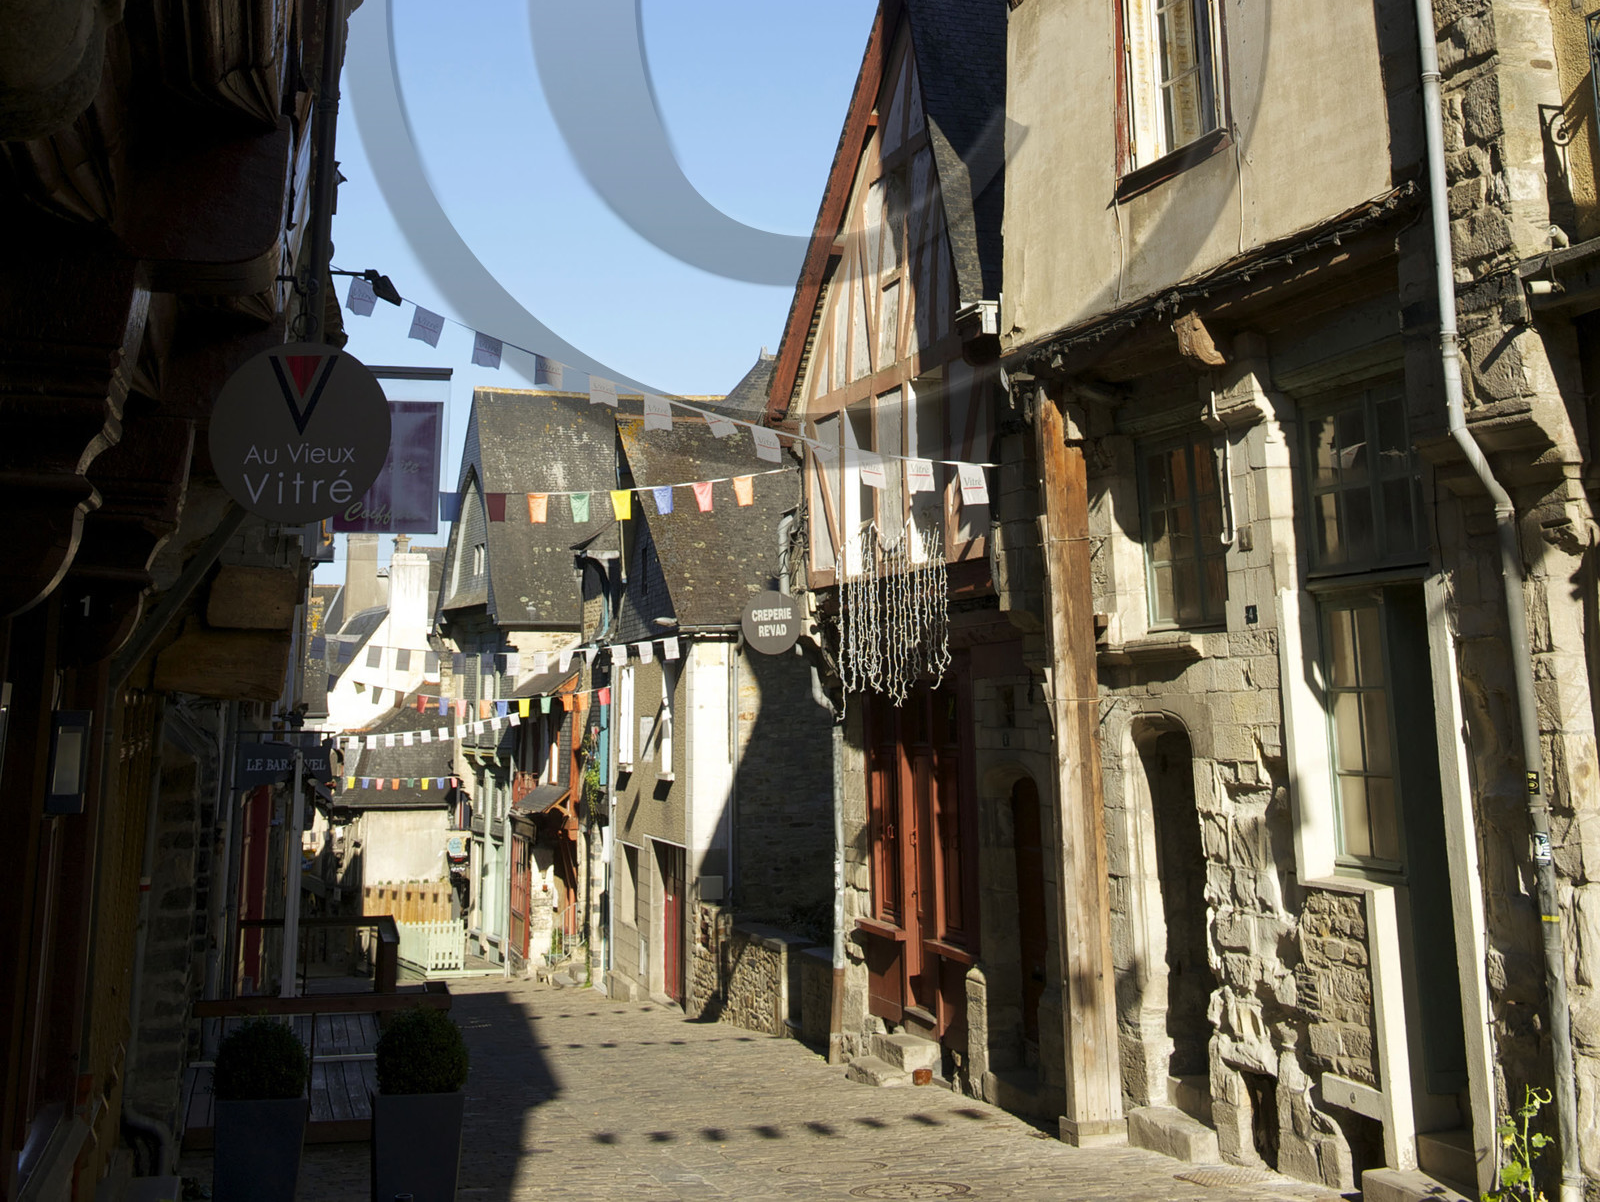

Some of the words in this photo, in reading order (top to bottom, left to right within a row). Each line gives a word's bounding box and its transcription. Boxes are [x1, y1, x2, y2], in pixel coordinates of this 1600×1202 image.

[243, 444, 278, 465] Au
[287, 442, 356, 464] Vieux
[910, 461, 931, 474] Vitré
[243, 469, 354, 505] Vitré
[963, 476, 983, 487] Vitré
[80, 595, 90, 617] 1
[751, 607, 793, 623] CREPERIE
[246, 758, 263, 772] LE
